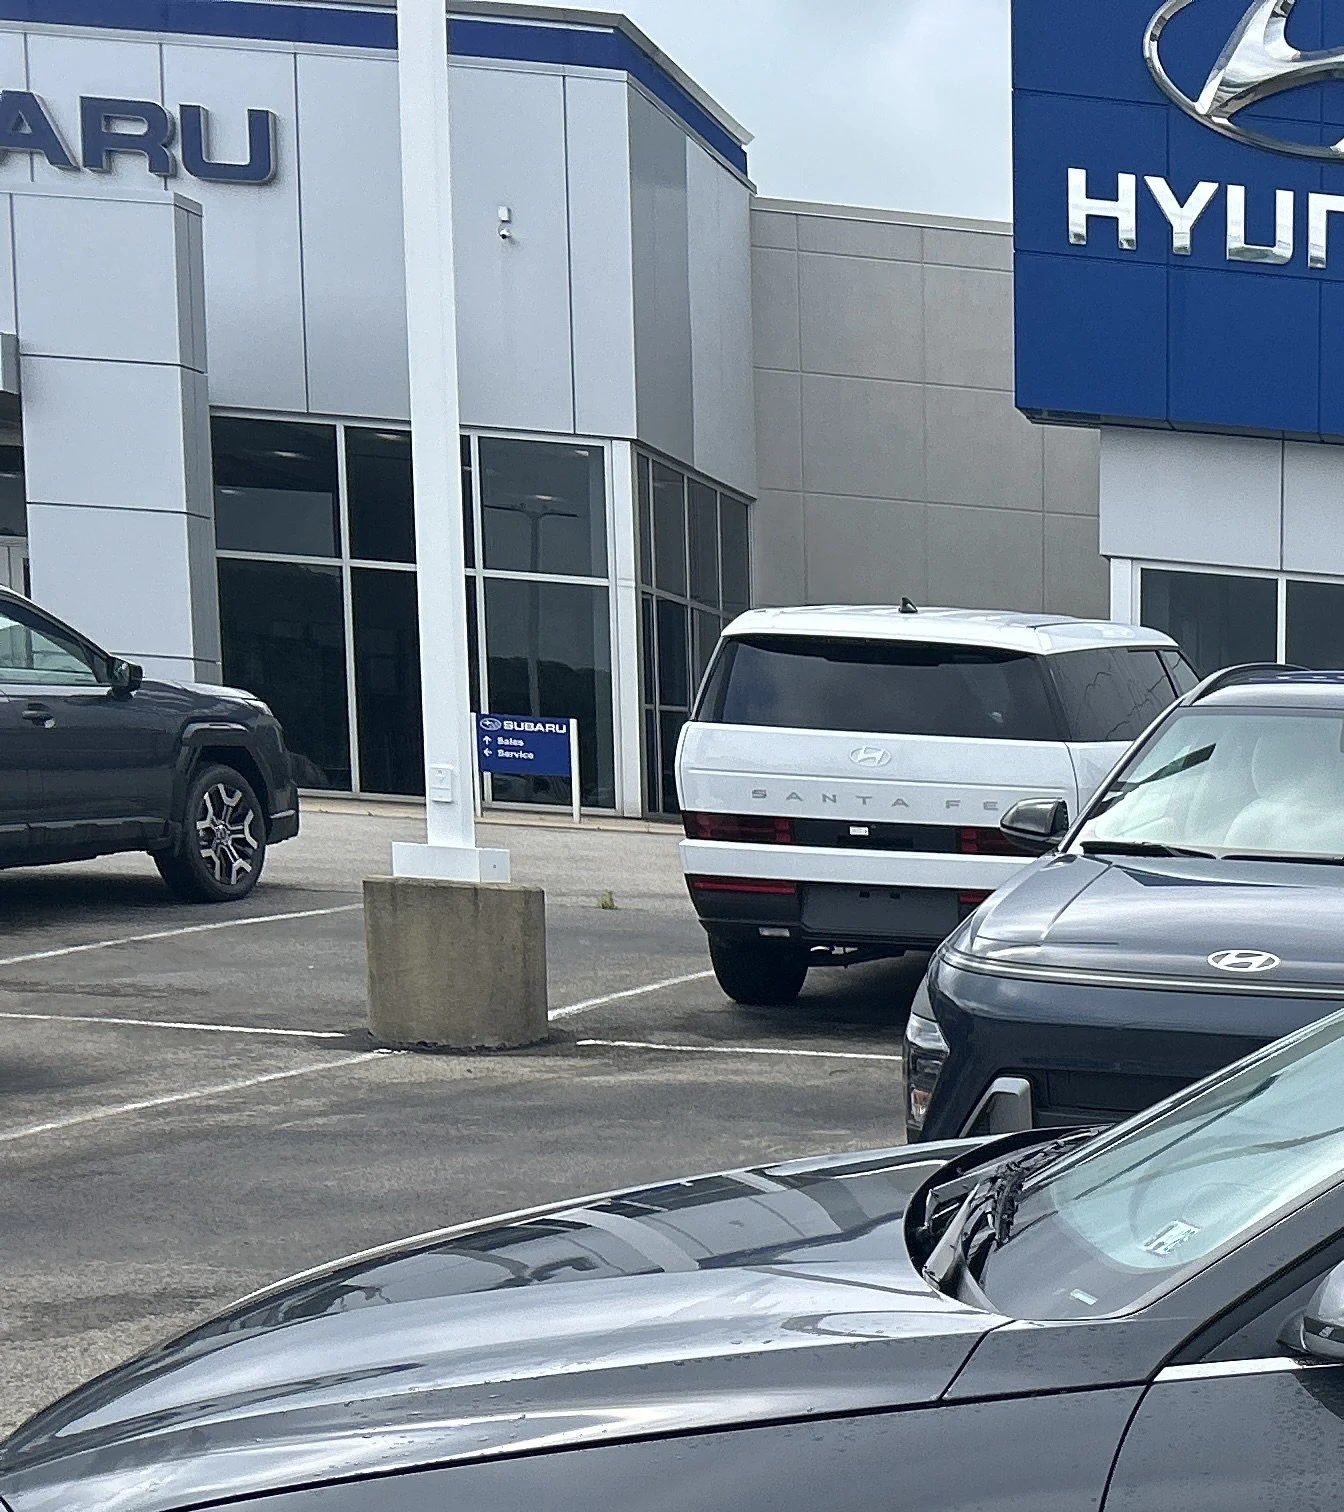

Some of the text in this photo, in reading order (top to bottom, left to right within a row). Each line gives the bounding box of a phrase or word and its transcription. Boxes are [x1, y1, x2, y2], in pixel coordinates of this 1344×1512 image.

[503, 720, 567, 734] SUBARU
[497, 736, 524, 747] Sales
[497, 749, 535, 760] Service
[751, 788, 999, 811] SANTA FE
